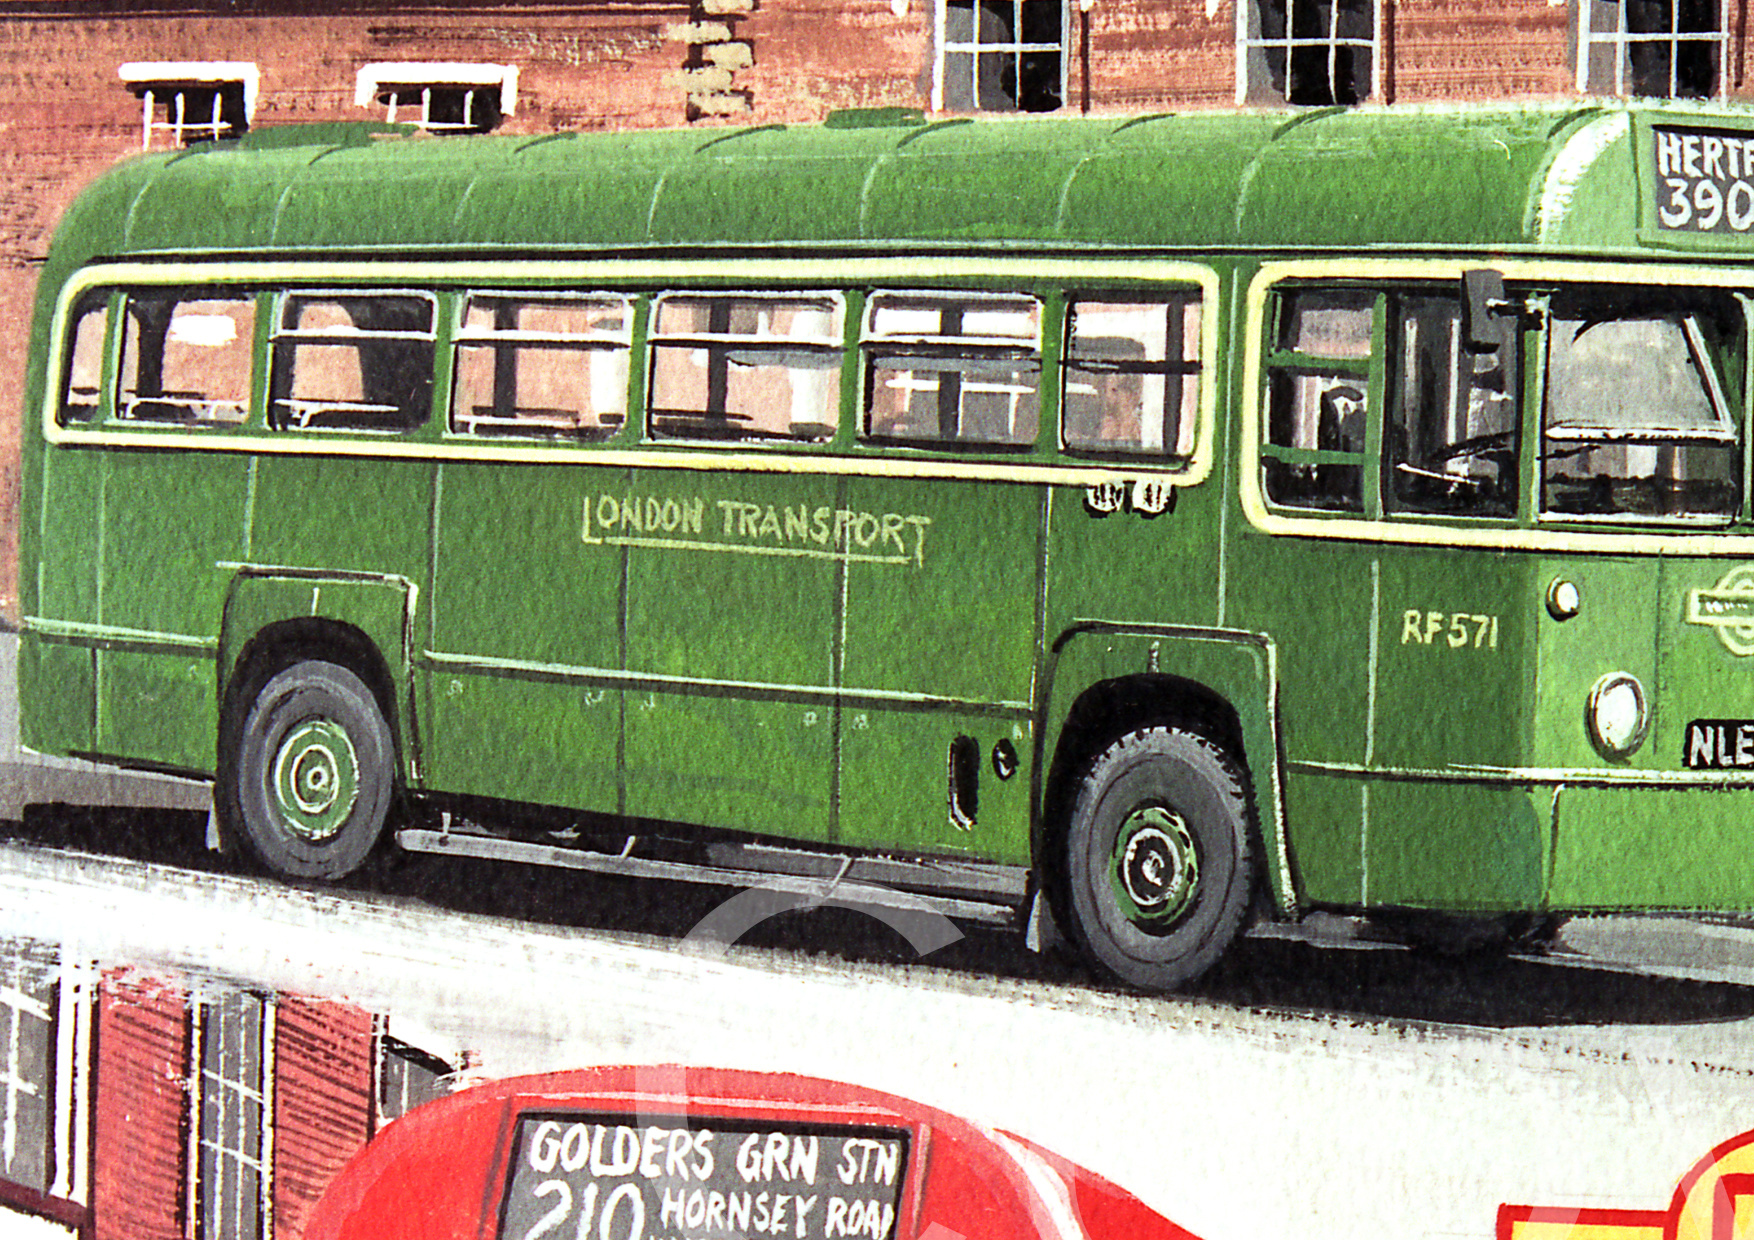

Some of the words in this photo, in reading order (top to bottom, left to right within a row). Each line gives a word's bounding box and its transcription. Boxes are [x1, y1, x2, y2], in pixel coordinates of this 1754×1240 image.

[583, 495, 703, 544] LONDON
[717, 500, 931, 567] TRANSPORT
[528, 1120, 715, 1182] GOLDERS
[736, 1131, 820, 1185] GRN
[836, 1138, 899, 1187] STN
[660, 1186, 817, 1238] HORNSEY
